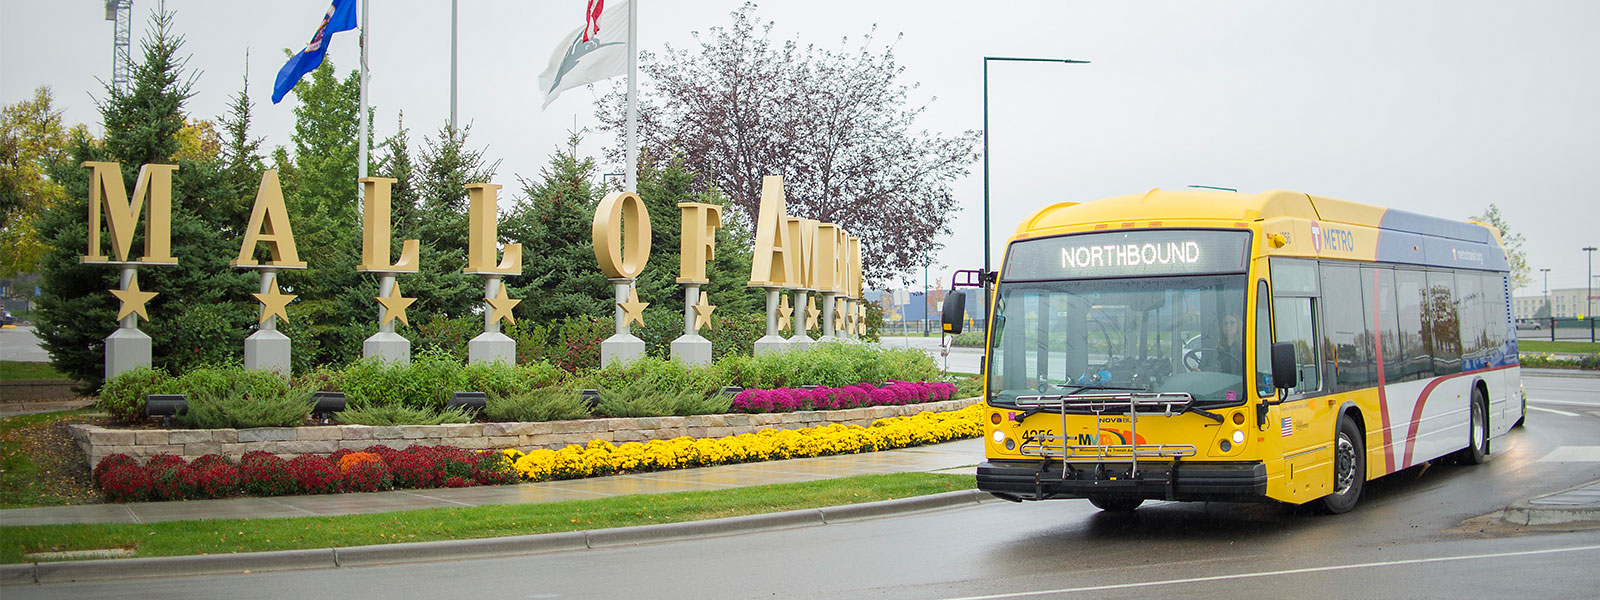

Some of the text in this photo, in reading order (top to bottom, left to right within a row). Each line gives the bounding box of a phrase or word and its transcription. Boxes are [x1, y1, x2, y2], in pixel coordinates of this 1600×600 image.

[79, 161, 522, 276] MALL
[592, 191, 723, 284] OF
[1323, 227, 1354, 252] METRO
[1061, 241, 1200, 268] NORTHBOUND
[1022, 429, 1055, 443] 4256
